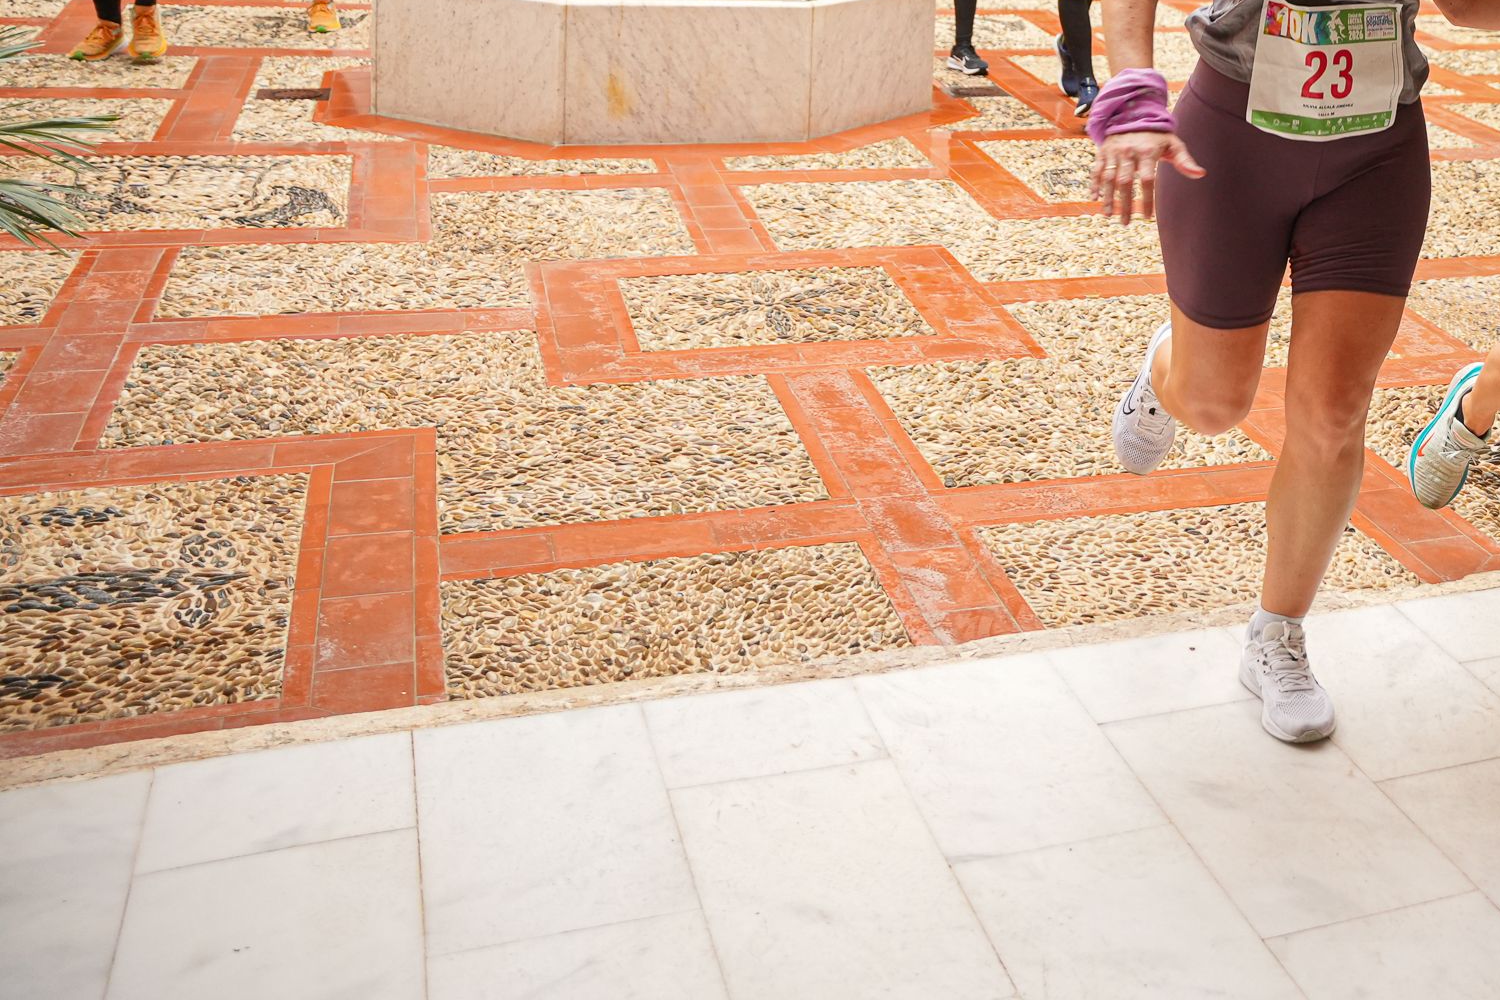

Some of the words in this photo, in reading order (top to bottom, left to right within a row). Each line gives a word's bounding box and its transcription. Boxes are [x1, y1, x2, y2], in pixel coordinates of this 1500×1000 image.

[1276, 6, 1317, 44] 10K
[1348, 30, 1363, 41] 2026
[1301, 49, 1353, 99] 23
